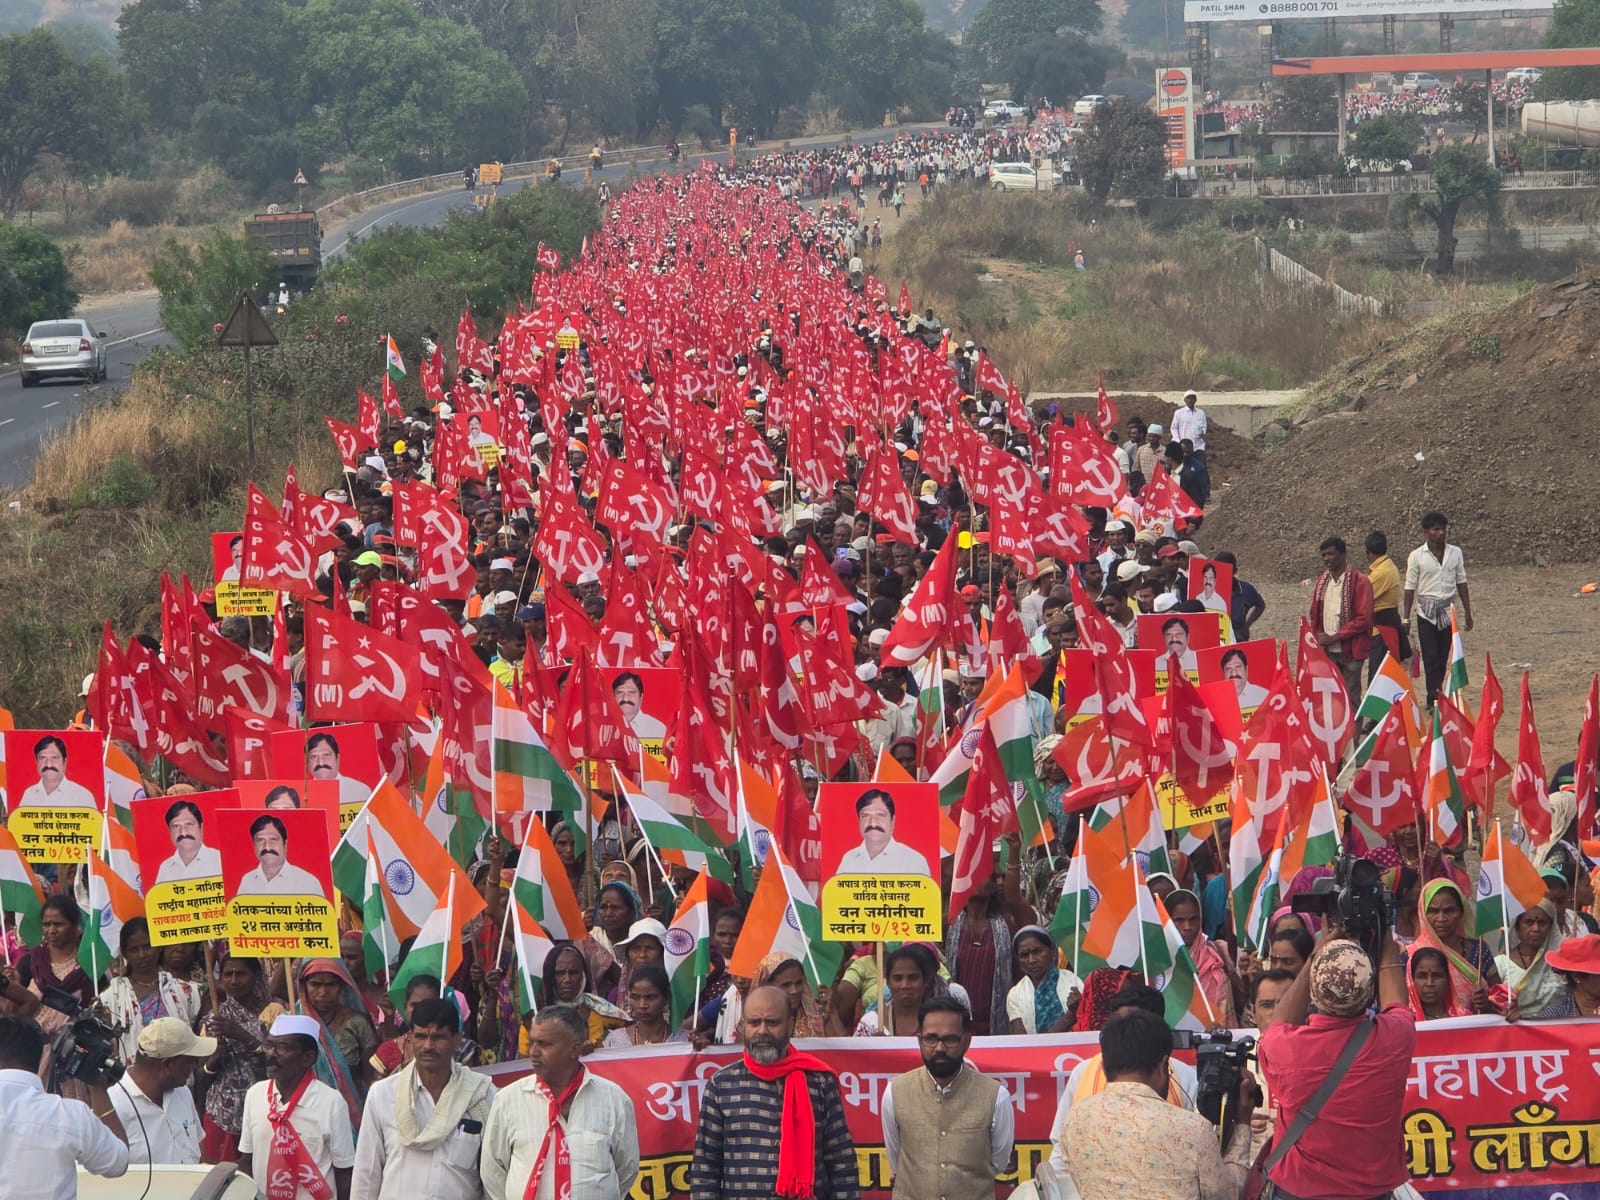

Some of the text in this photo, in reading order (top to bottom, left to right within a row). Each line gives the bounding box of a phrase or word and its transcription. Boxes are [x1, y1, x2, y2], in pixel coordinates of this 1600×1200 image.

[1058, 441, 1073, 496] CPI(M)
[604, 468, 624, 522] CPI(M)
[400, 491, 417, 542] CPI(M)
[246, 521, 264, 580] CPI(M)
[198, 633, 214, 719] CPI(M)
[22, 834, 40, 843] वन
[49, 846, 81, 860] ७/१२
[173, 884, 185, 894] पेठ
[837, 880, 859, 888] अपात्र
[862, 877, 877, 890] दावे
[879, 880, 895, 888] पात्र
[879, 890, 910, 901] क्षेत्रासह
[157, 898, 185, 912] राष्ट्रीय
[294, 902, 327, 915] शेतीला
[839, 904, 925, 918] वन जमीनीचा
[193, 912, 200, 920] व
[159, 929, 178, 938] काम
[179, 925, 210, 937] तात्काळ
[241, 919, 322, 933] २४ तास अखंडीत
[829, 920, 866, 934] स्वतंत्र
[871, 920, 911, 938] ७/१२
[233, 933, 333, 954] वीजपुरवठा करा.
